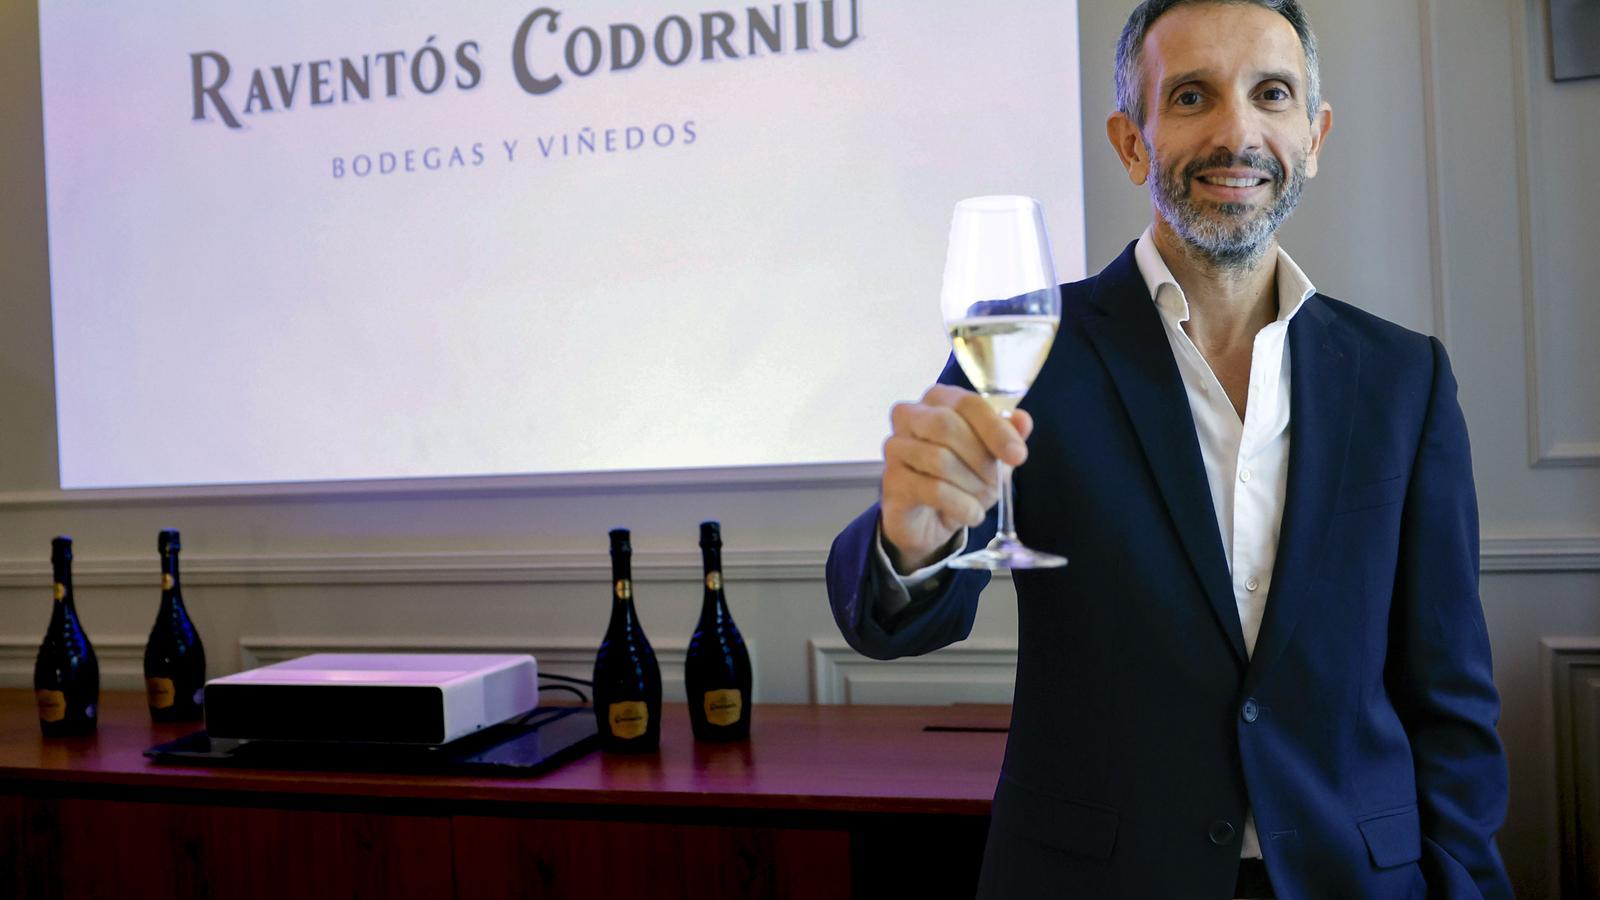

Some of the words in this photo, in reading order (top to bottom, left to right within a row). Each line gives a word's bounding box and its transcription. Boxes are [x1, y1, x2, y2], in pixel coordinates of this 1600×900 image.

[189, 35, 482, 129] RAVENTÓS
[332, 142, 485, 179] BODEGAS
[503, 139, 519, 162] Y
[537, 120, 698, 159] VIÑEDOS
